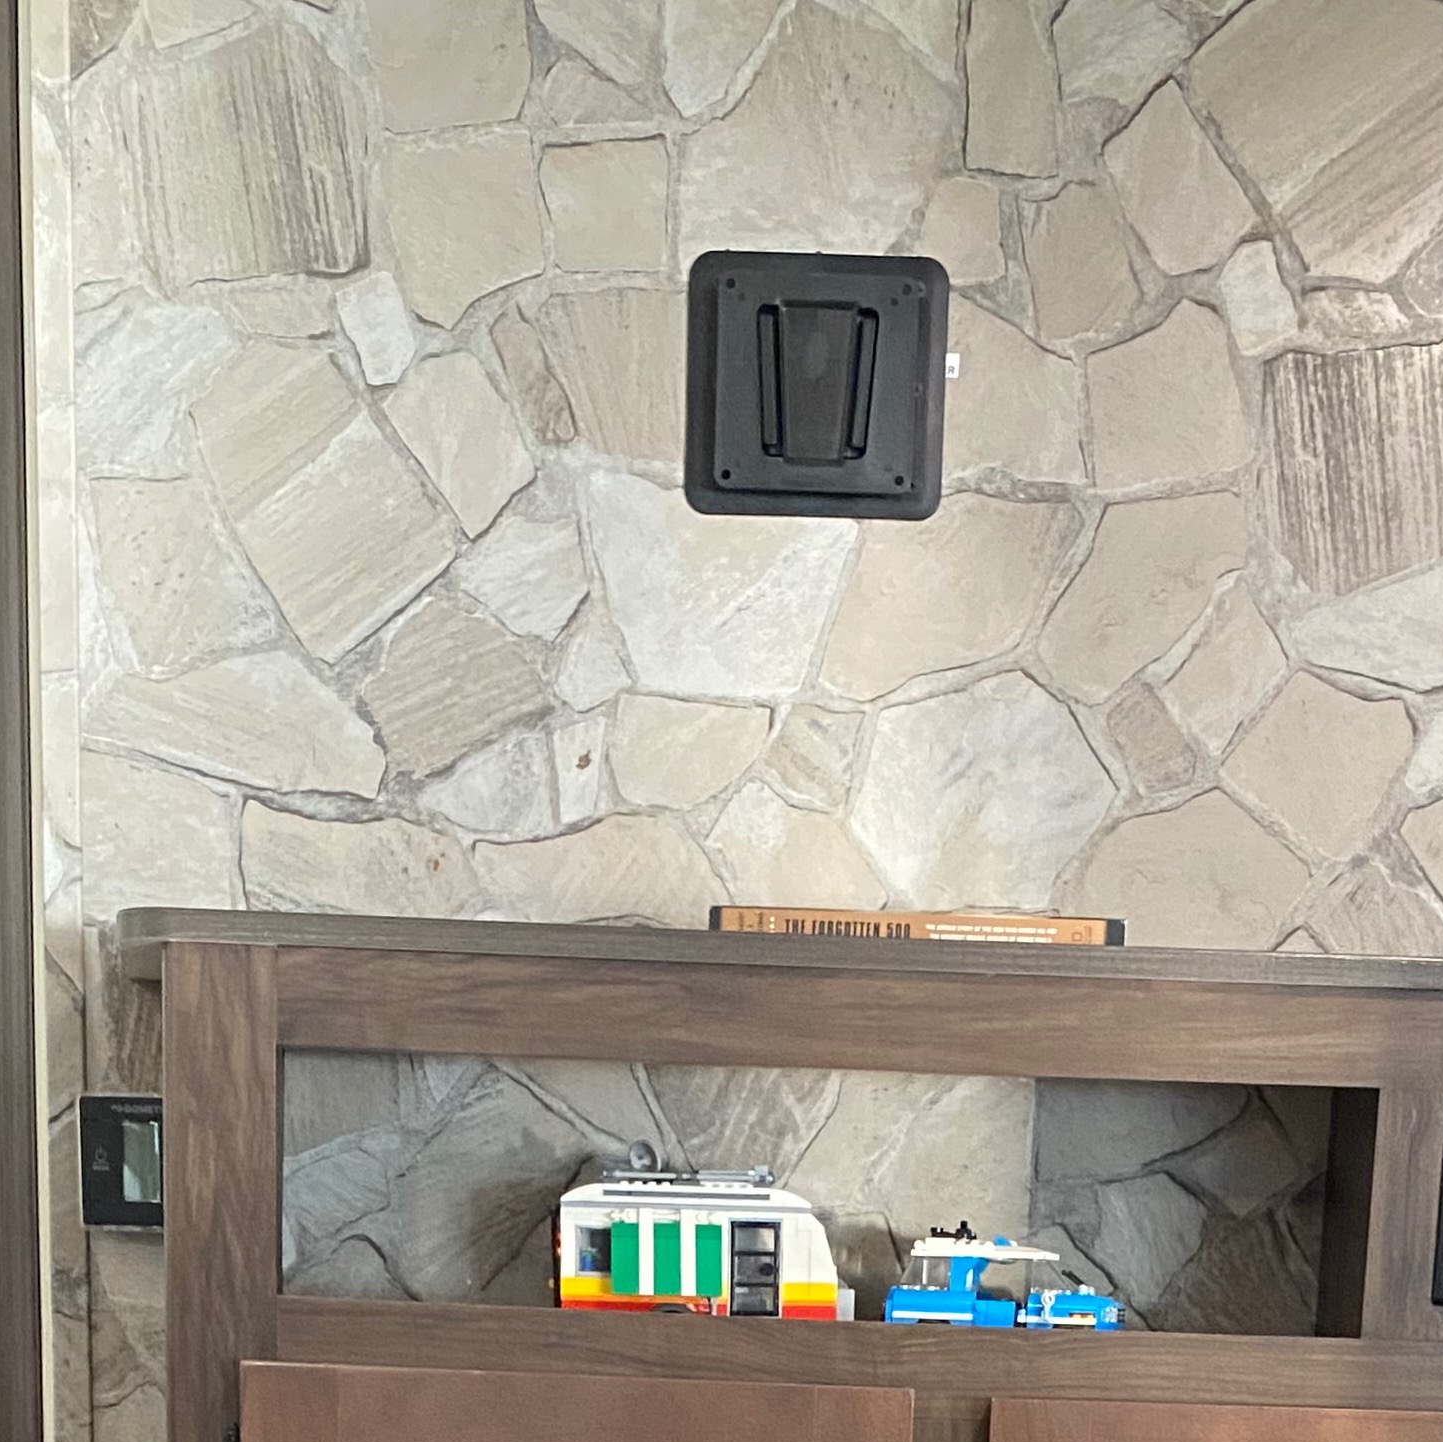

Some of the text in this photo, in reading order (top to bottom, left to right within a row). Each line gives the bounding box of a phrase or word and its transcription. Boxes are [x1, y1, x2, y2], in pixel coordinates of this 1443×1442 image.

[785, 918, 805, 934] THE
[812, 919, 880, 938] FORGOTTEN
[886, 922, 911, 939] 500
